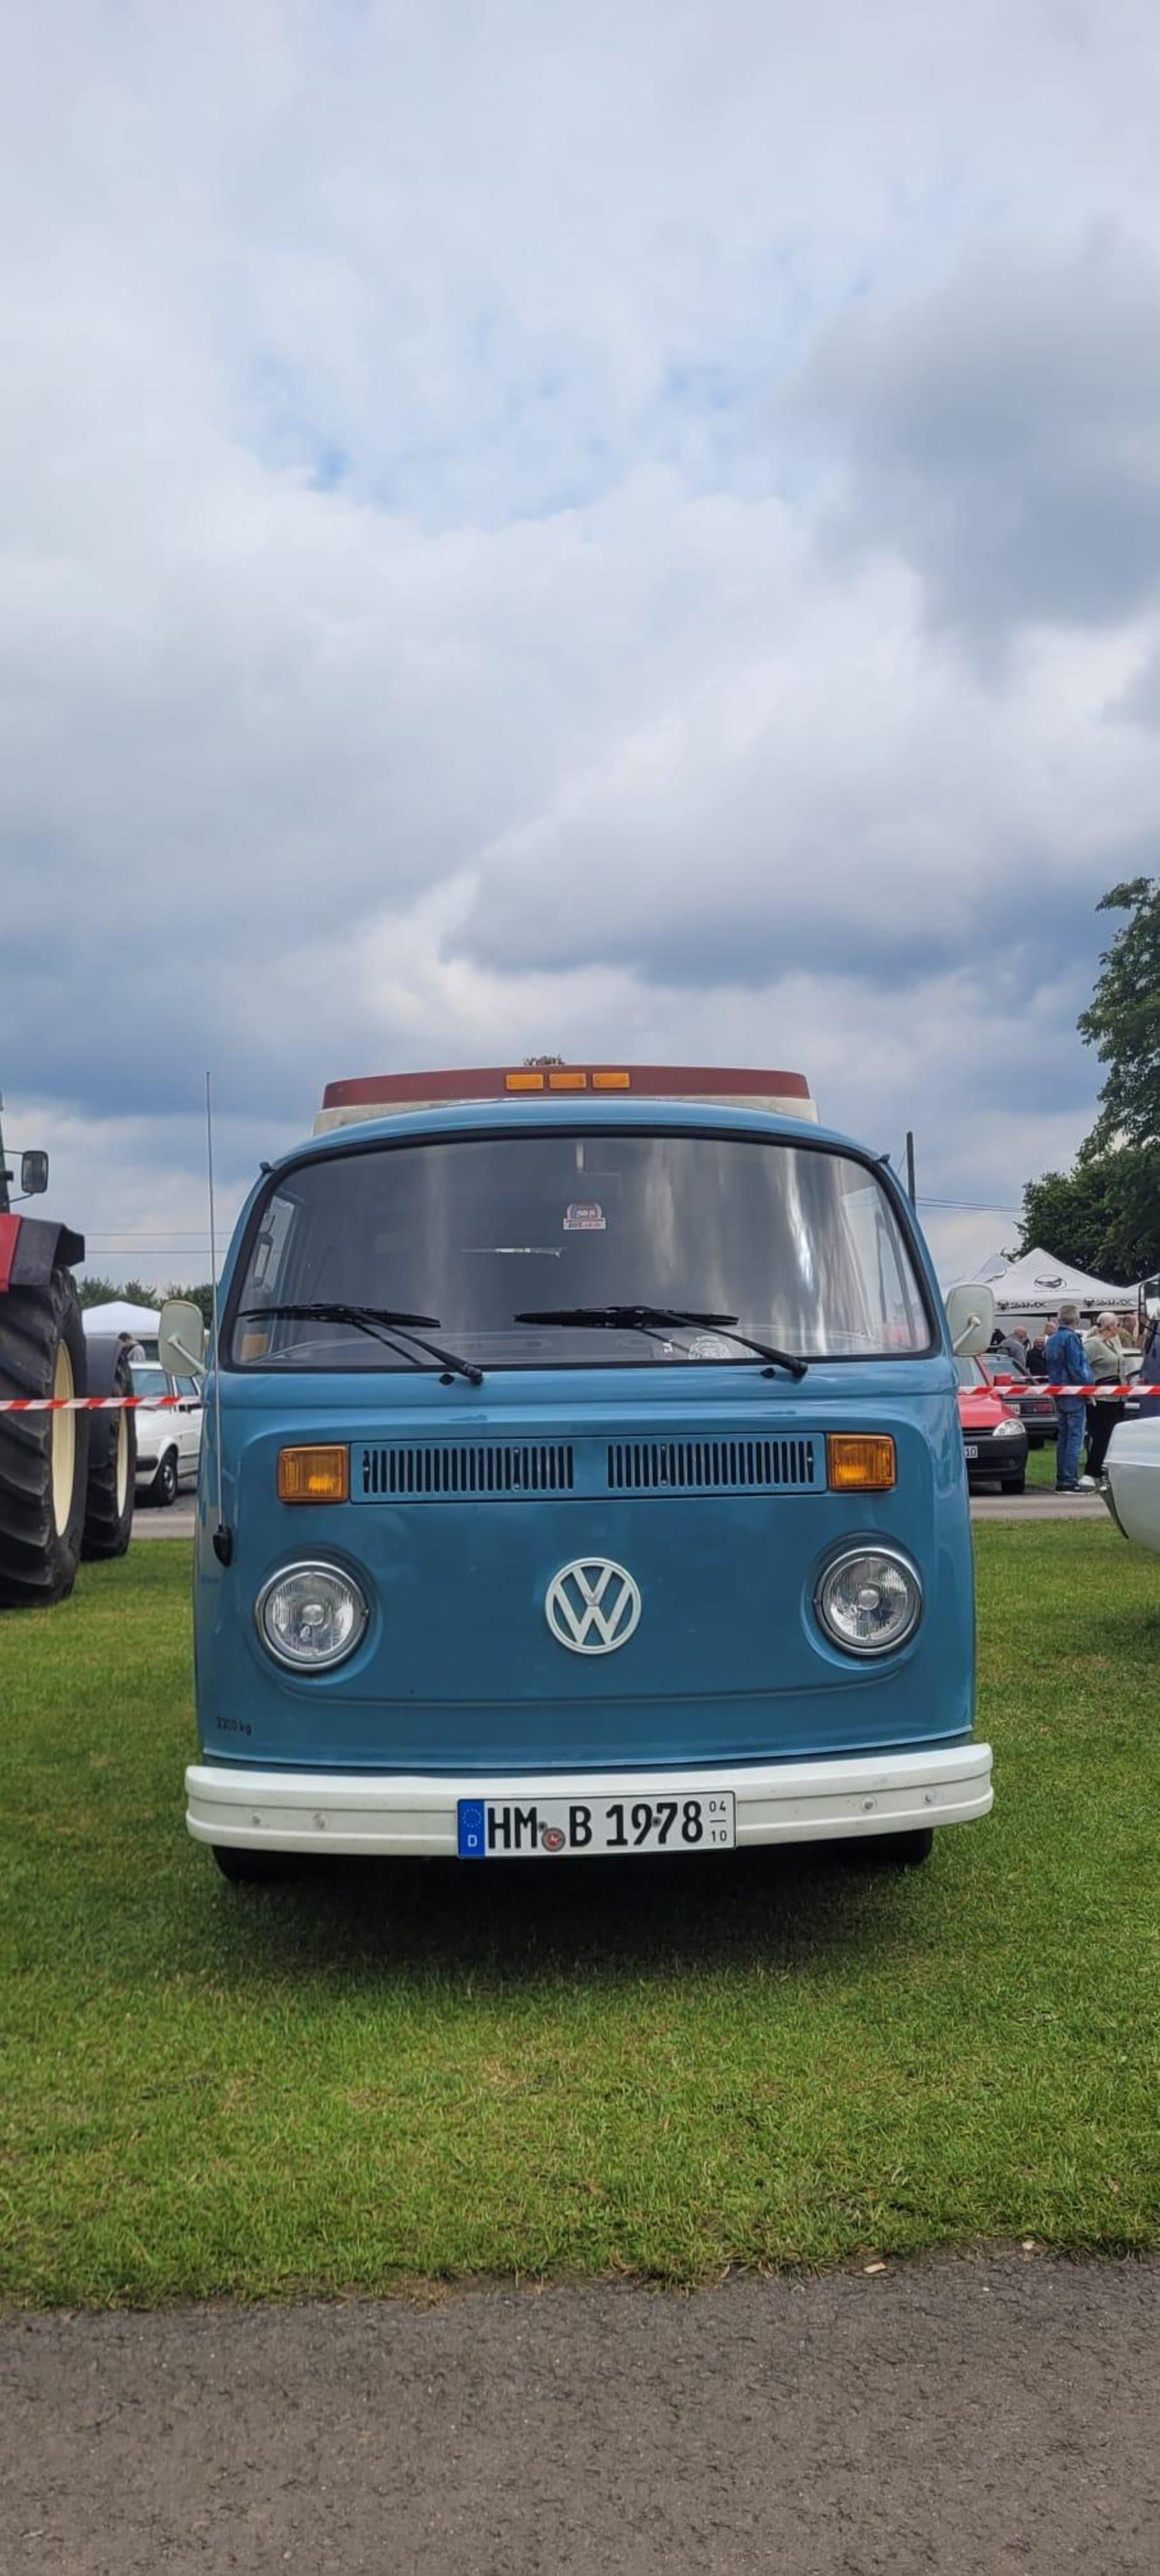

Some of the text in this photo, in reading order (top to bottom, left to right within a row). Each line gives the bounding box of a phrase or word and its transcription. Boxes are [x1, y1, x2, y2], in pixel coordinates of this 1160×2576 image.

[550, 1563, 635, 1647] VW
[709, 1800, 726, 1812] 04
[488, 1800, 703, 1849] HM B 1978
[468, 1835, 477, 1847] D
[711, 1829, 727, 1842] 10
